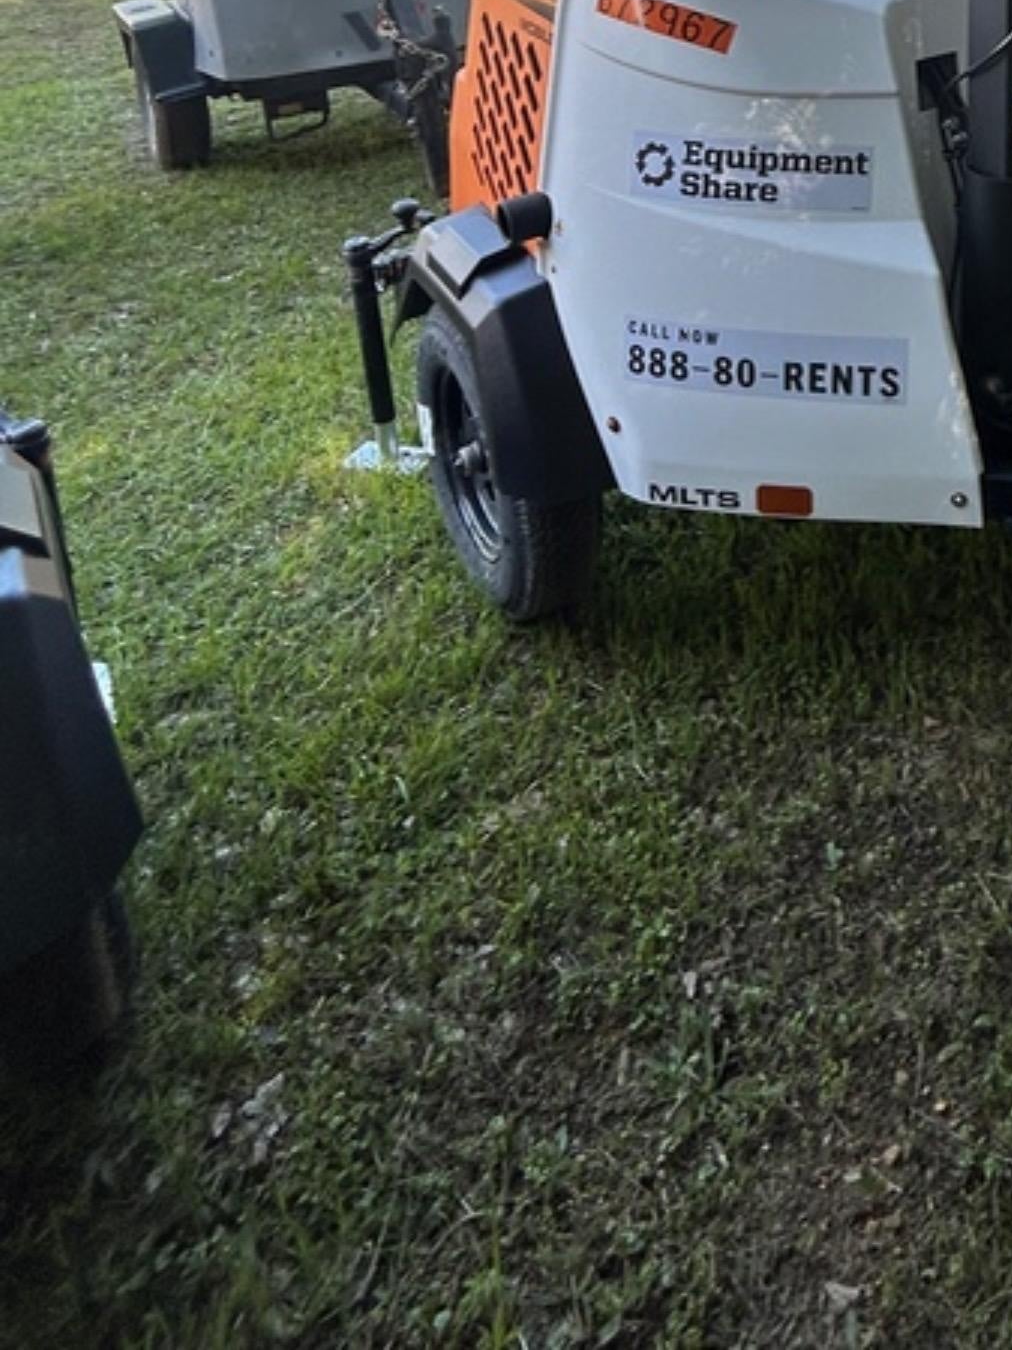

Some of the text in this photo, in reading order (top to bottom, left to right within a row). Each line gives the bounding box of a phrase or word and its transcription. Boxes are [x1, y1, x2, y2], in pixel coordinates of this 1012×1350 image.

[683, 141, 868, 177] Equipment
[680, 172, 778, 201] Share
[628, 320, 719, 345] CALL NOW
[629, 345, 900, 398] 888-80-RENTS
[649, 483, 741, 508] MLTS
